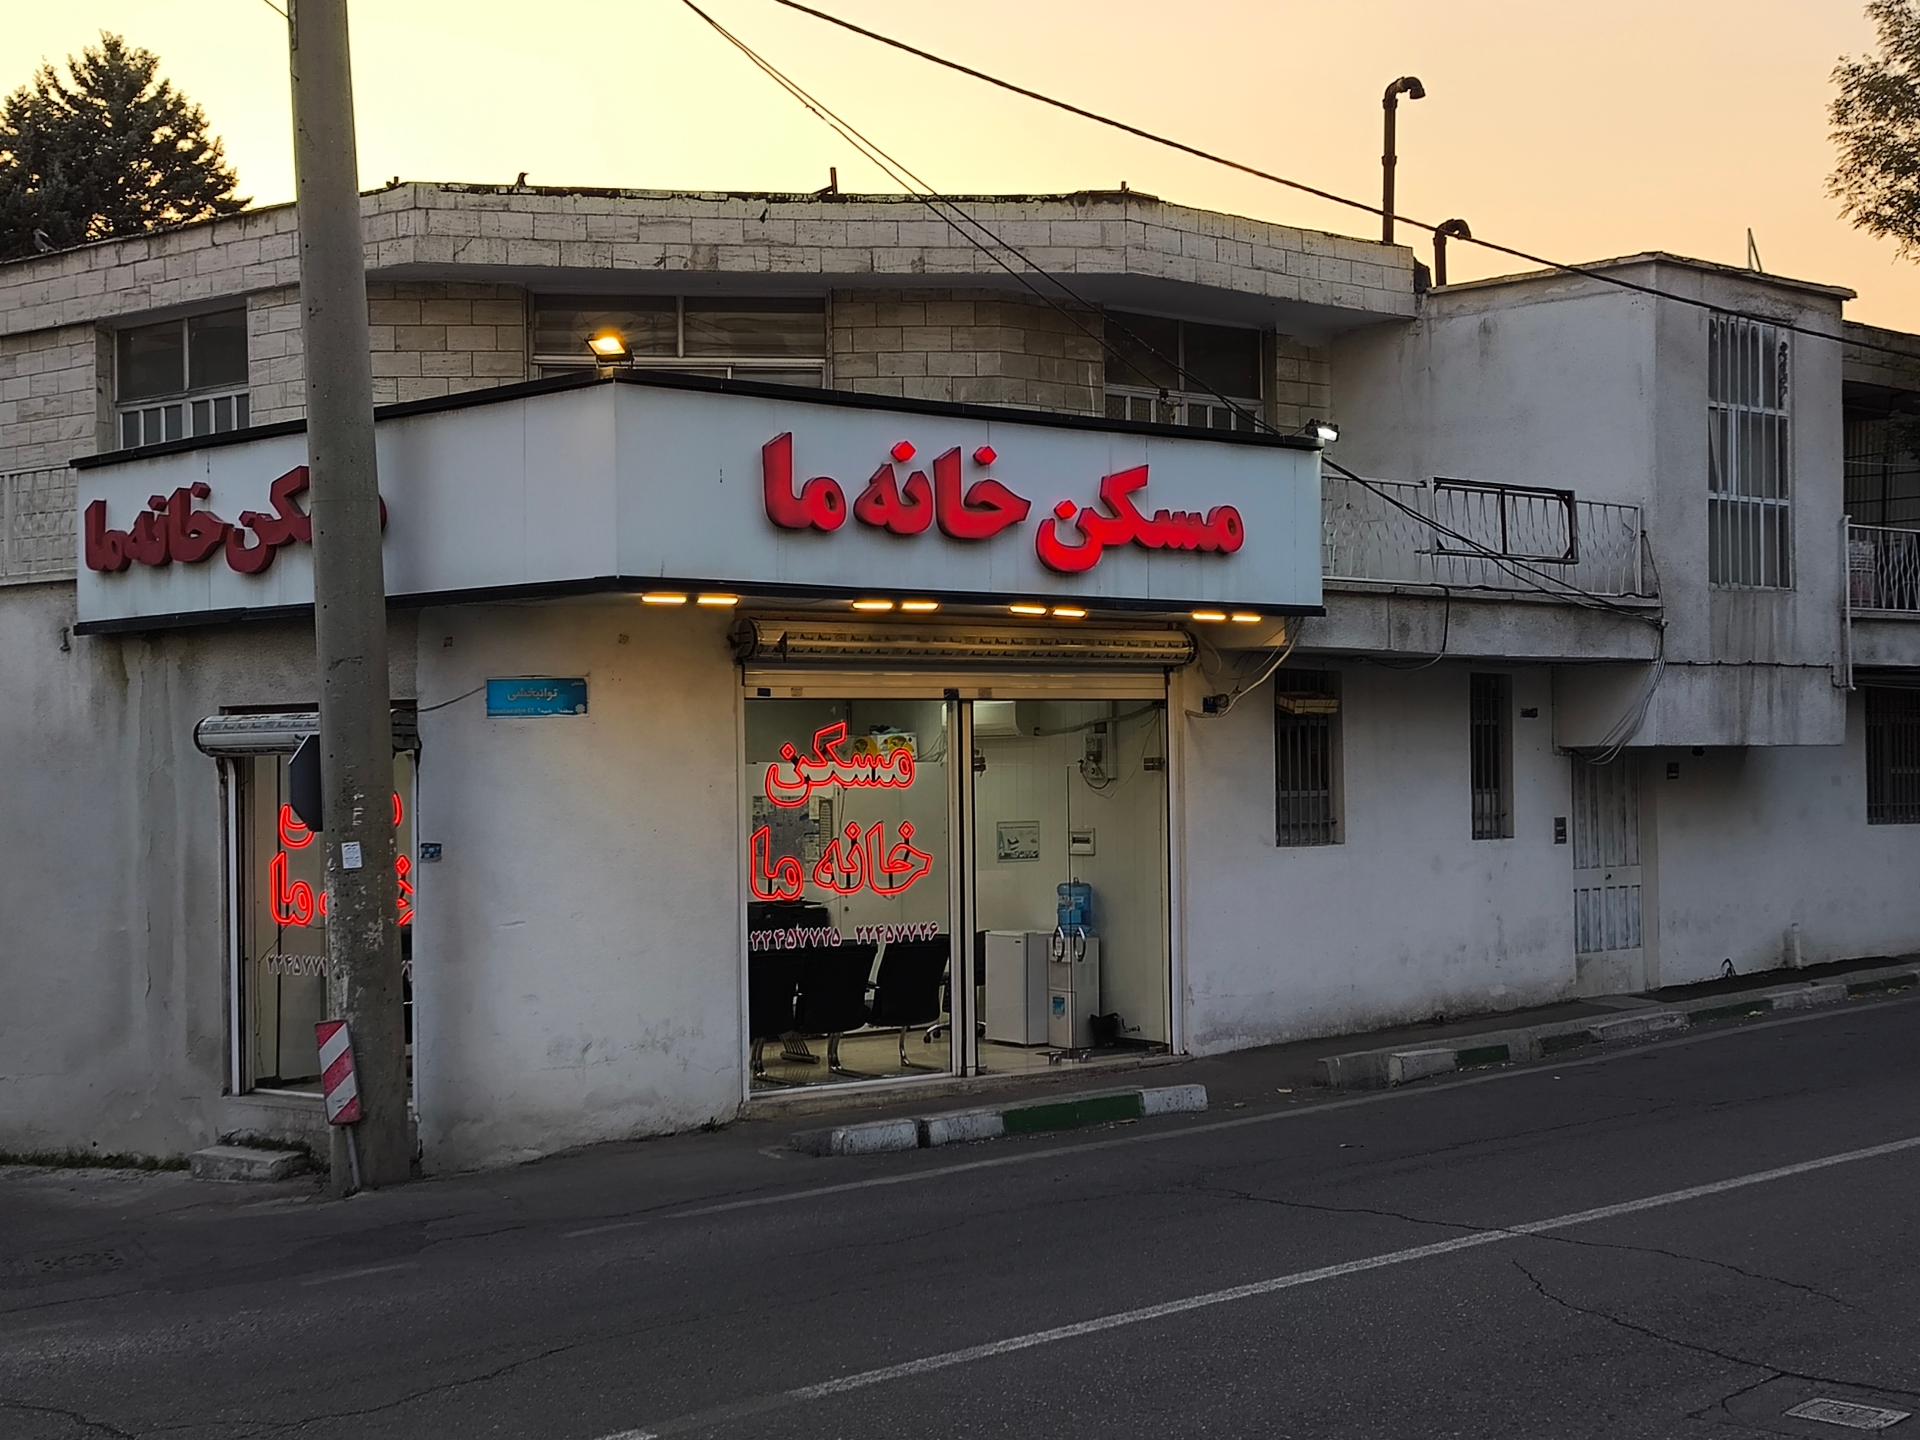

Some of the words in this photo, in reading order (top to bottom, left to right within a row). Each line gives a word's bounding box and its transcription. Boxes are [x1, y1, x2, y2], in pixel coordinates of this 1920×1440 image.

[762, 432, 847, 532] ما
[853, 440, 1031, 540] خانه
[1035, 464, 1244, 574] مسکن
[85, 499, 131, 573] ما
[124, 482, 233, 567] خانه
[765, 720, 916, 808] مسکن
[269, 850, 314, 927] ما
[750, 825, 804, 902] ما
[813, 821, 933, 895] خانه
[751, 926, 842, 951] ۲۲۴۵۷۷۲۵
[855, 921, 938, 946] ۲۲۴۵۷۷۲۶
